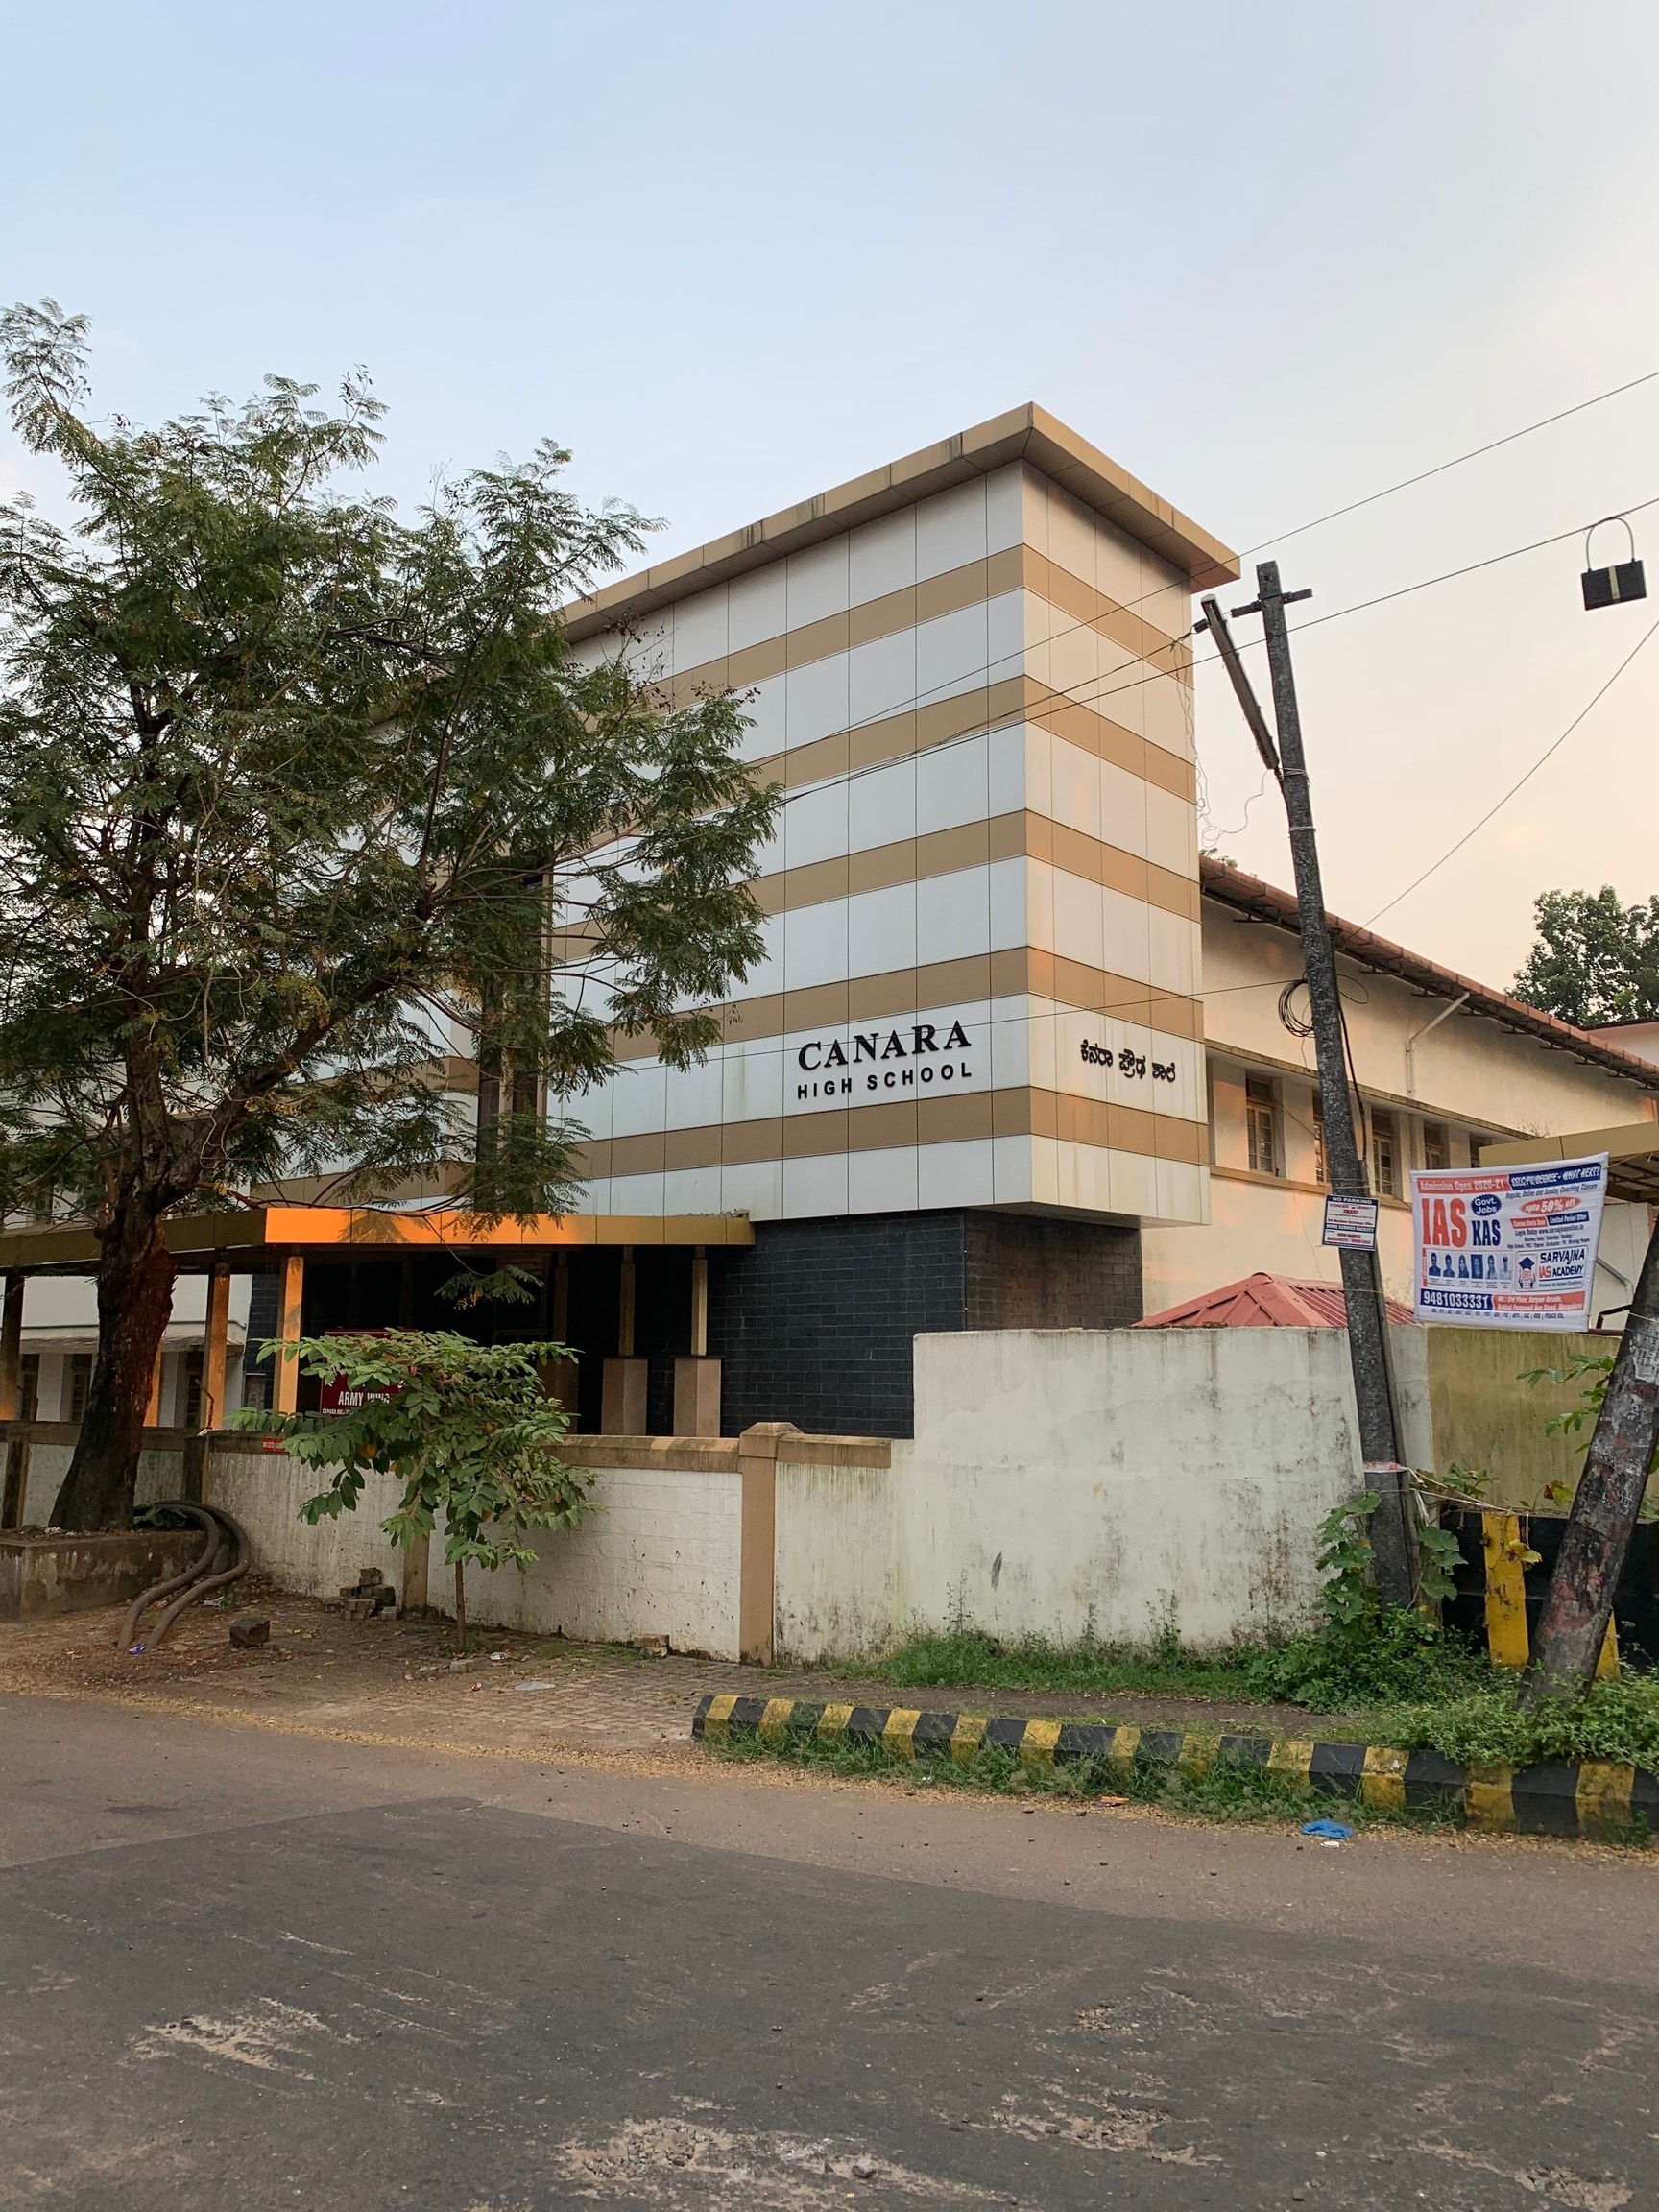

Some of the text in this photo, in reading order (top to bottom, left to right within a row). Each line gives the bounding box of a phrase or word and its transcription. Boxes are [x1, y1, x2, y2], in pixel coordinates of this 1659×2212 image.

[798, 1020, 972, 1071] CANARA
[1080, 1039, 1114, 1068] ಕೆನರಾ
[1152, 1062, 1176, 1083] ಶಾಲೆ
[798, 1062, 972, 1099] HIGH SCHOOL
[1580, 1166, 1600, 1178] NEXT?
[1421, 1178, 1505, 1192] Admission Open 2020-21
[1477, 1206, 1498, 1214] Jobs
[1525, 1198, 1576, 1213] upto 50% off
[1422, 1198, 1467, 1248] IAS
[1472, 1219, 1501, 1246] KAS
[1540, 1248, 1585, 1264] SARVAJNA
[1539, 1265, 1584, 1278] IAS ACADEMY
[1423, 1290, 1489, 1309] 9481033331
[338, 1391, 364, 1407] ARMY
